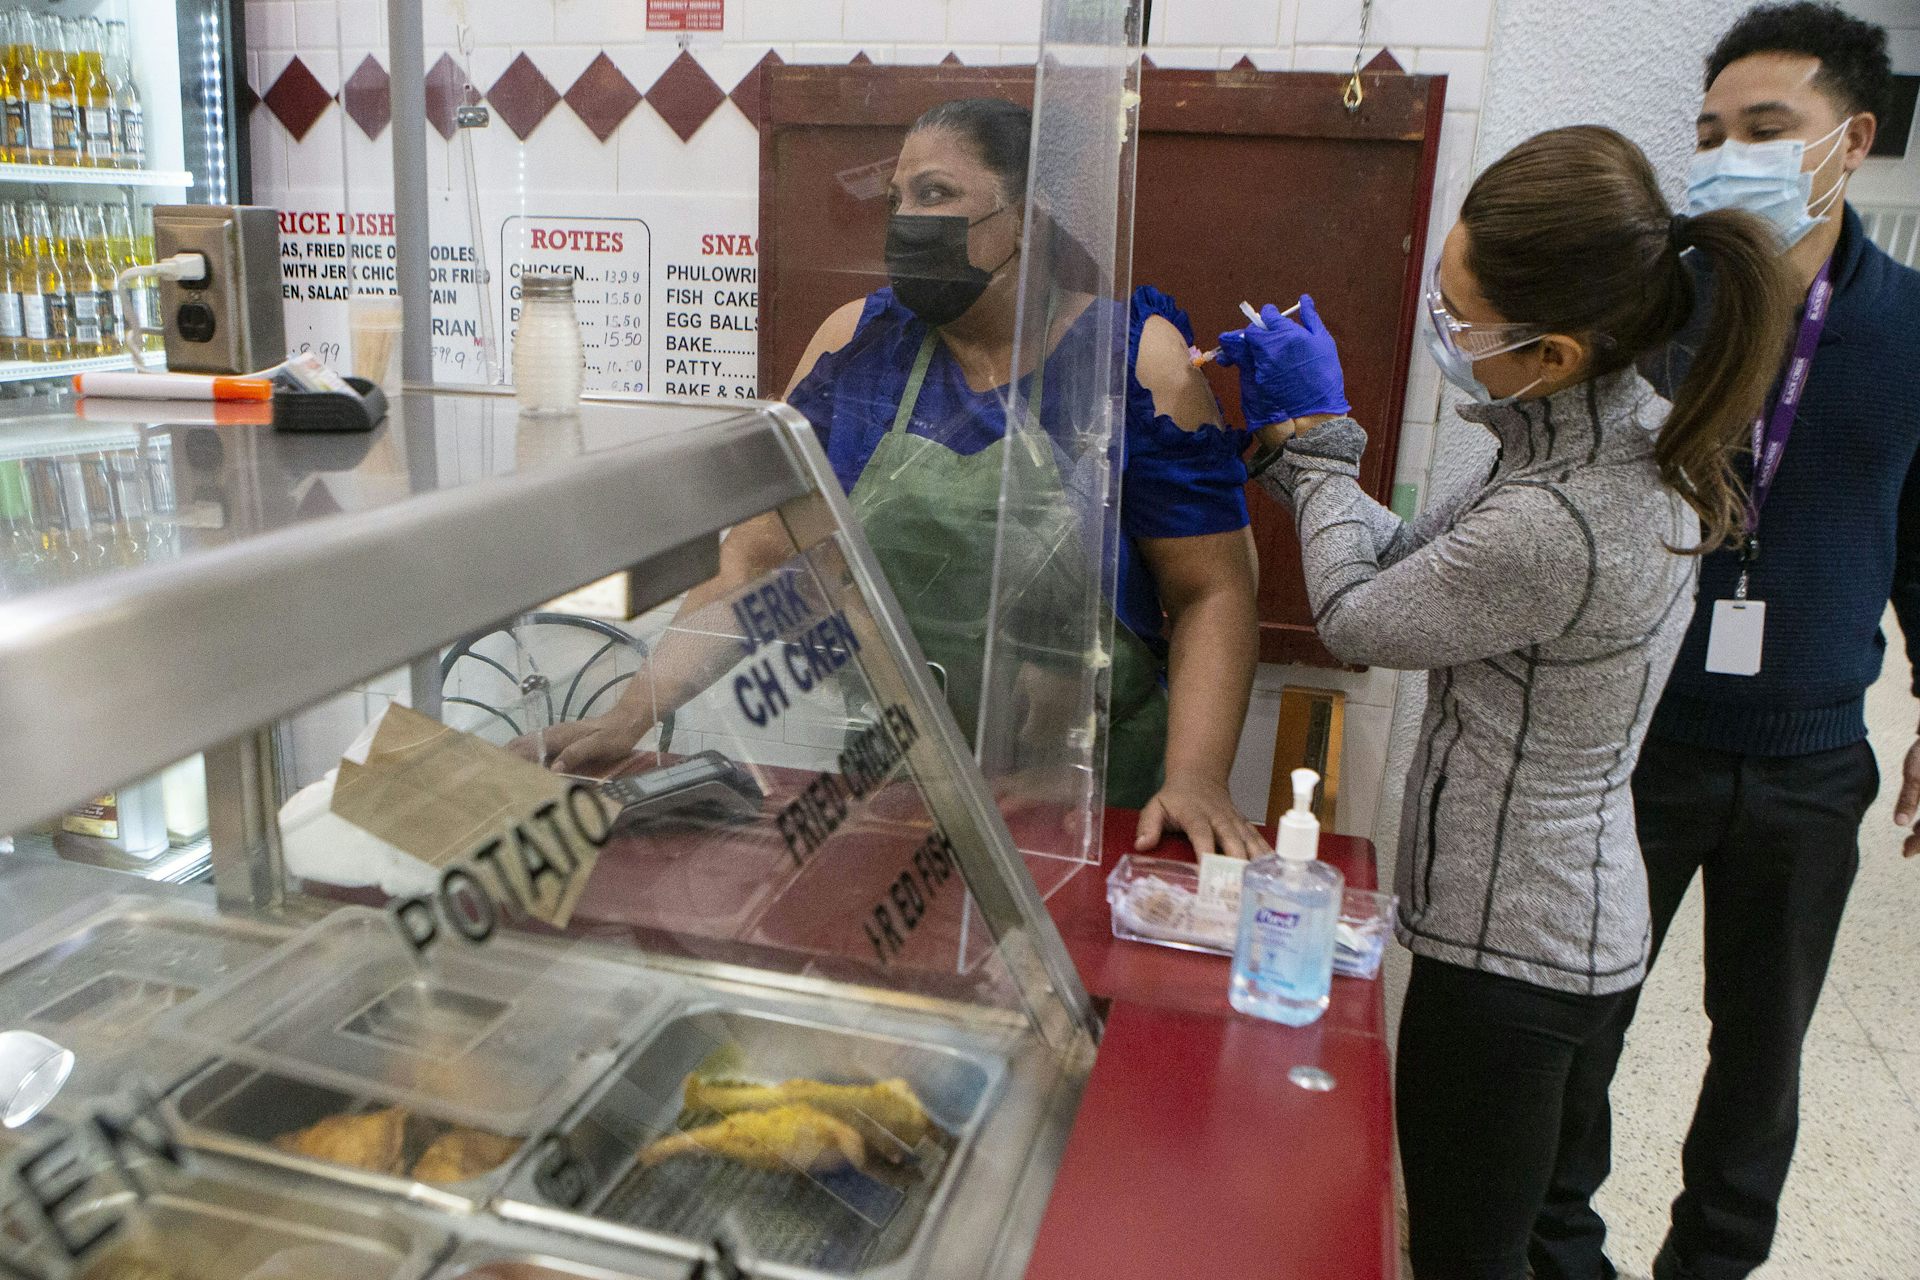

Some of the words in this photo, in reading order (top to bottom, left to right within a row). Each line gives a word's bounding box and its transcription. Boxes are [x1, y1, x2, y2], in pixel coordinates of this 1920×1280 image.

[531, 229, 624, 252] ROTIES
[701, 234, 759, 256] SNA
[306, 243, 345, 258] FRIED
[351, 244, 382, 259] RICE
[283, 264, 317, 278] WITH
[362, 266, 397, 280] CHIC
[667, 264, 757, 283] PHULOWRI
[308, 285, 349, 300] SALAD
[430, 289, 457, 304] AIN
[667, 288, 702, 305] FISH
[714, 290, 758, 307] CAKE
[666, 312, 702, 329] EGG
[666, 382, 711, 397] BAKE
[731, 569, 813, 655] JERK
[734, 609, 862, 727] CHCKEN
[775, 770, 848, 868] FRIED
[394, 783, 612, 962] POTATO
[863, 869, 926, 966] FRED
